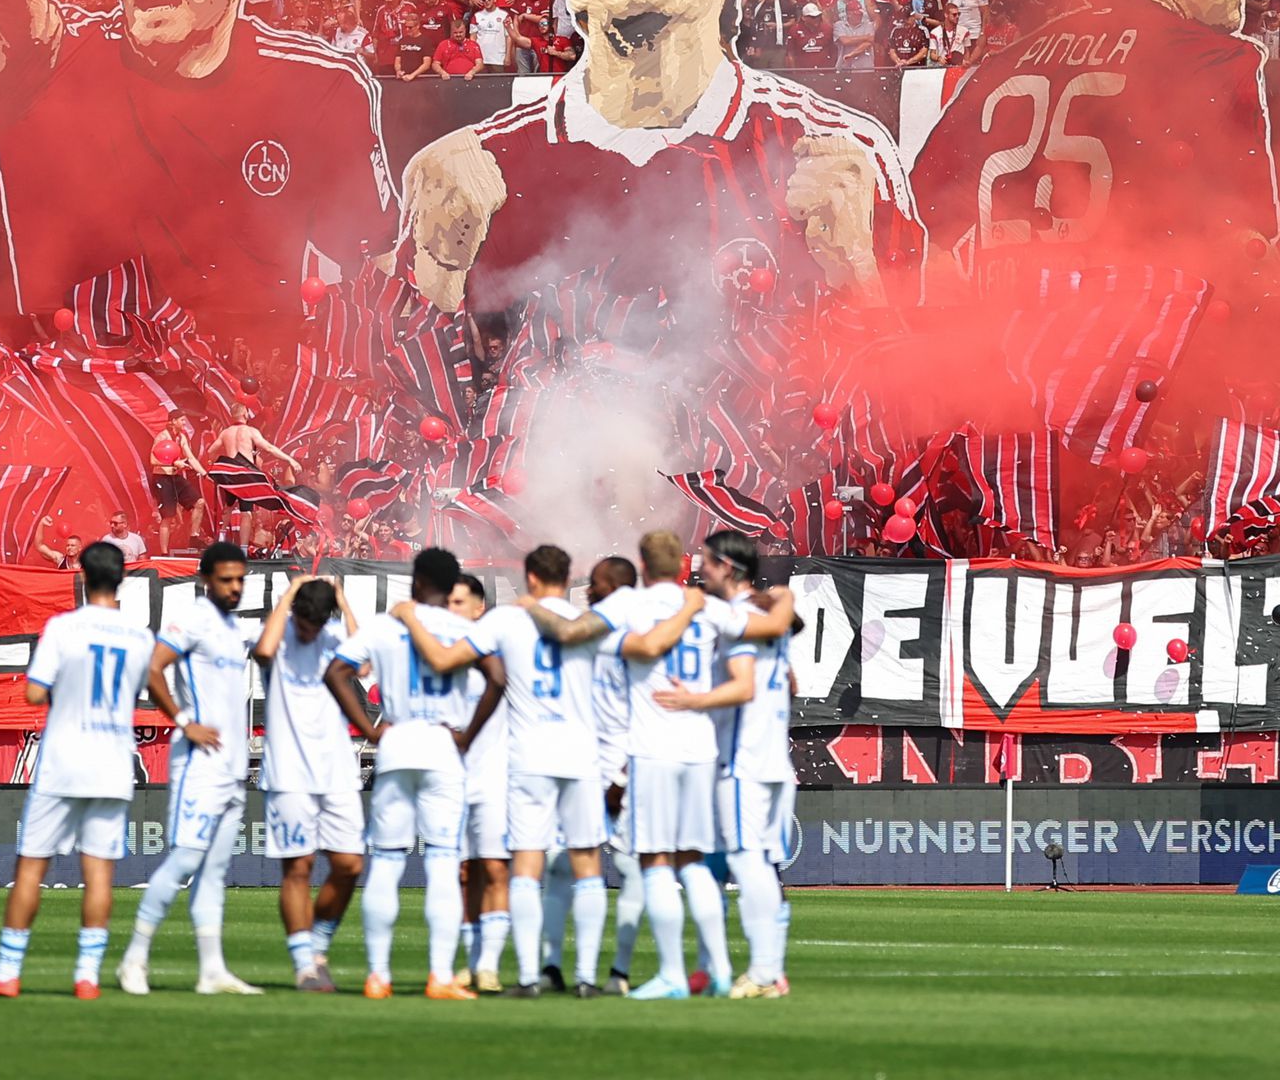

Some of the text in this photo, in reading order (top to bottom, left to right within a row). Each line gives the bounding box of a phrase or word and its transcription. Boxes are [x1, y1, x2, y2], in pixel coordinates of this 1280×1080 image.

[1014, 28, 1138, 70] PINOLA
[247, 164, 285, 183] FCN
[977, 70, 1128, 249] 25
[788, 572, 930, 702] DE
[89, 643, 127, 712] 11
[821, 816, 1120, 854] NÜRNBERGER
